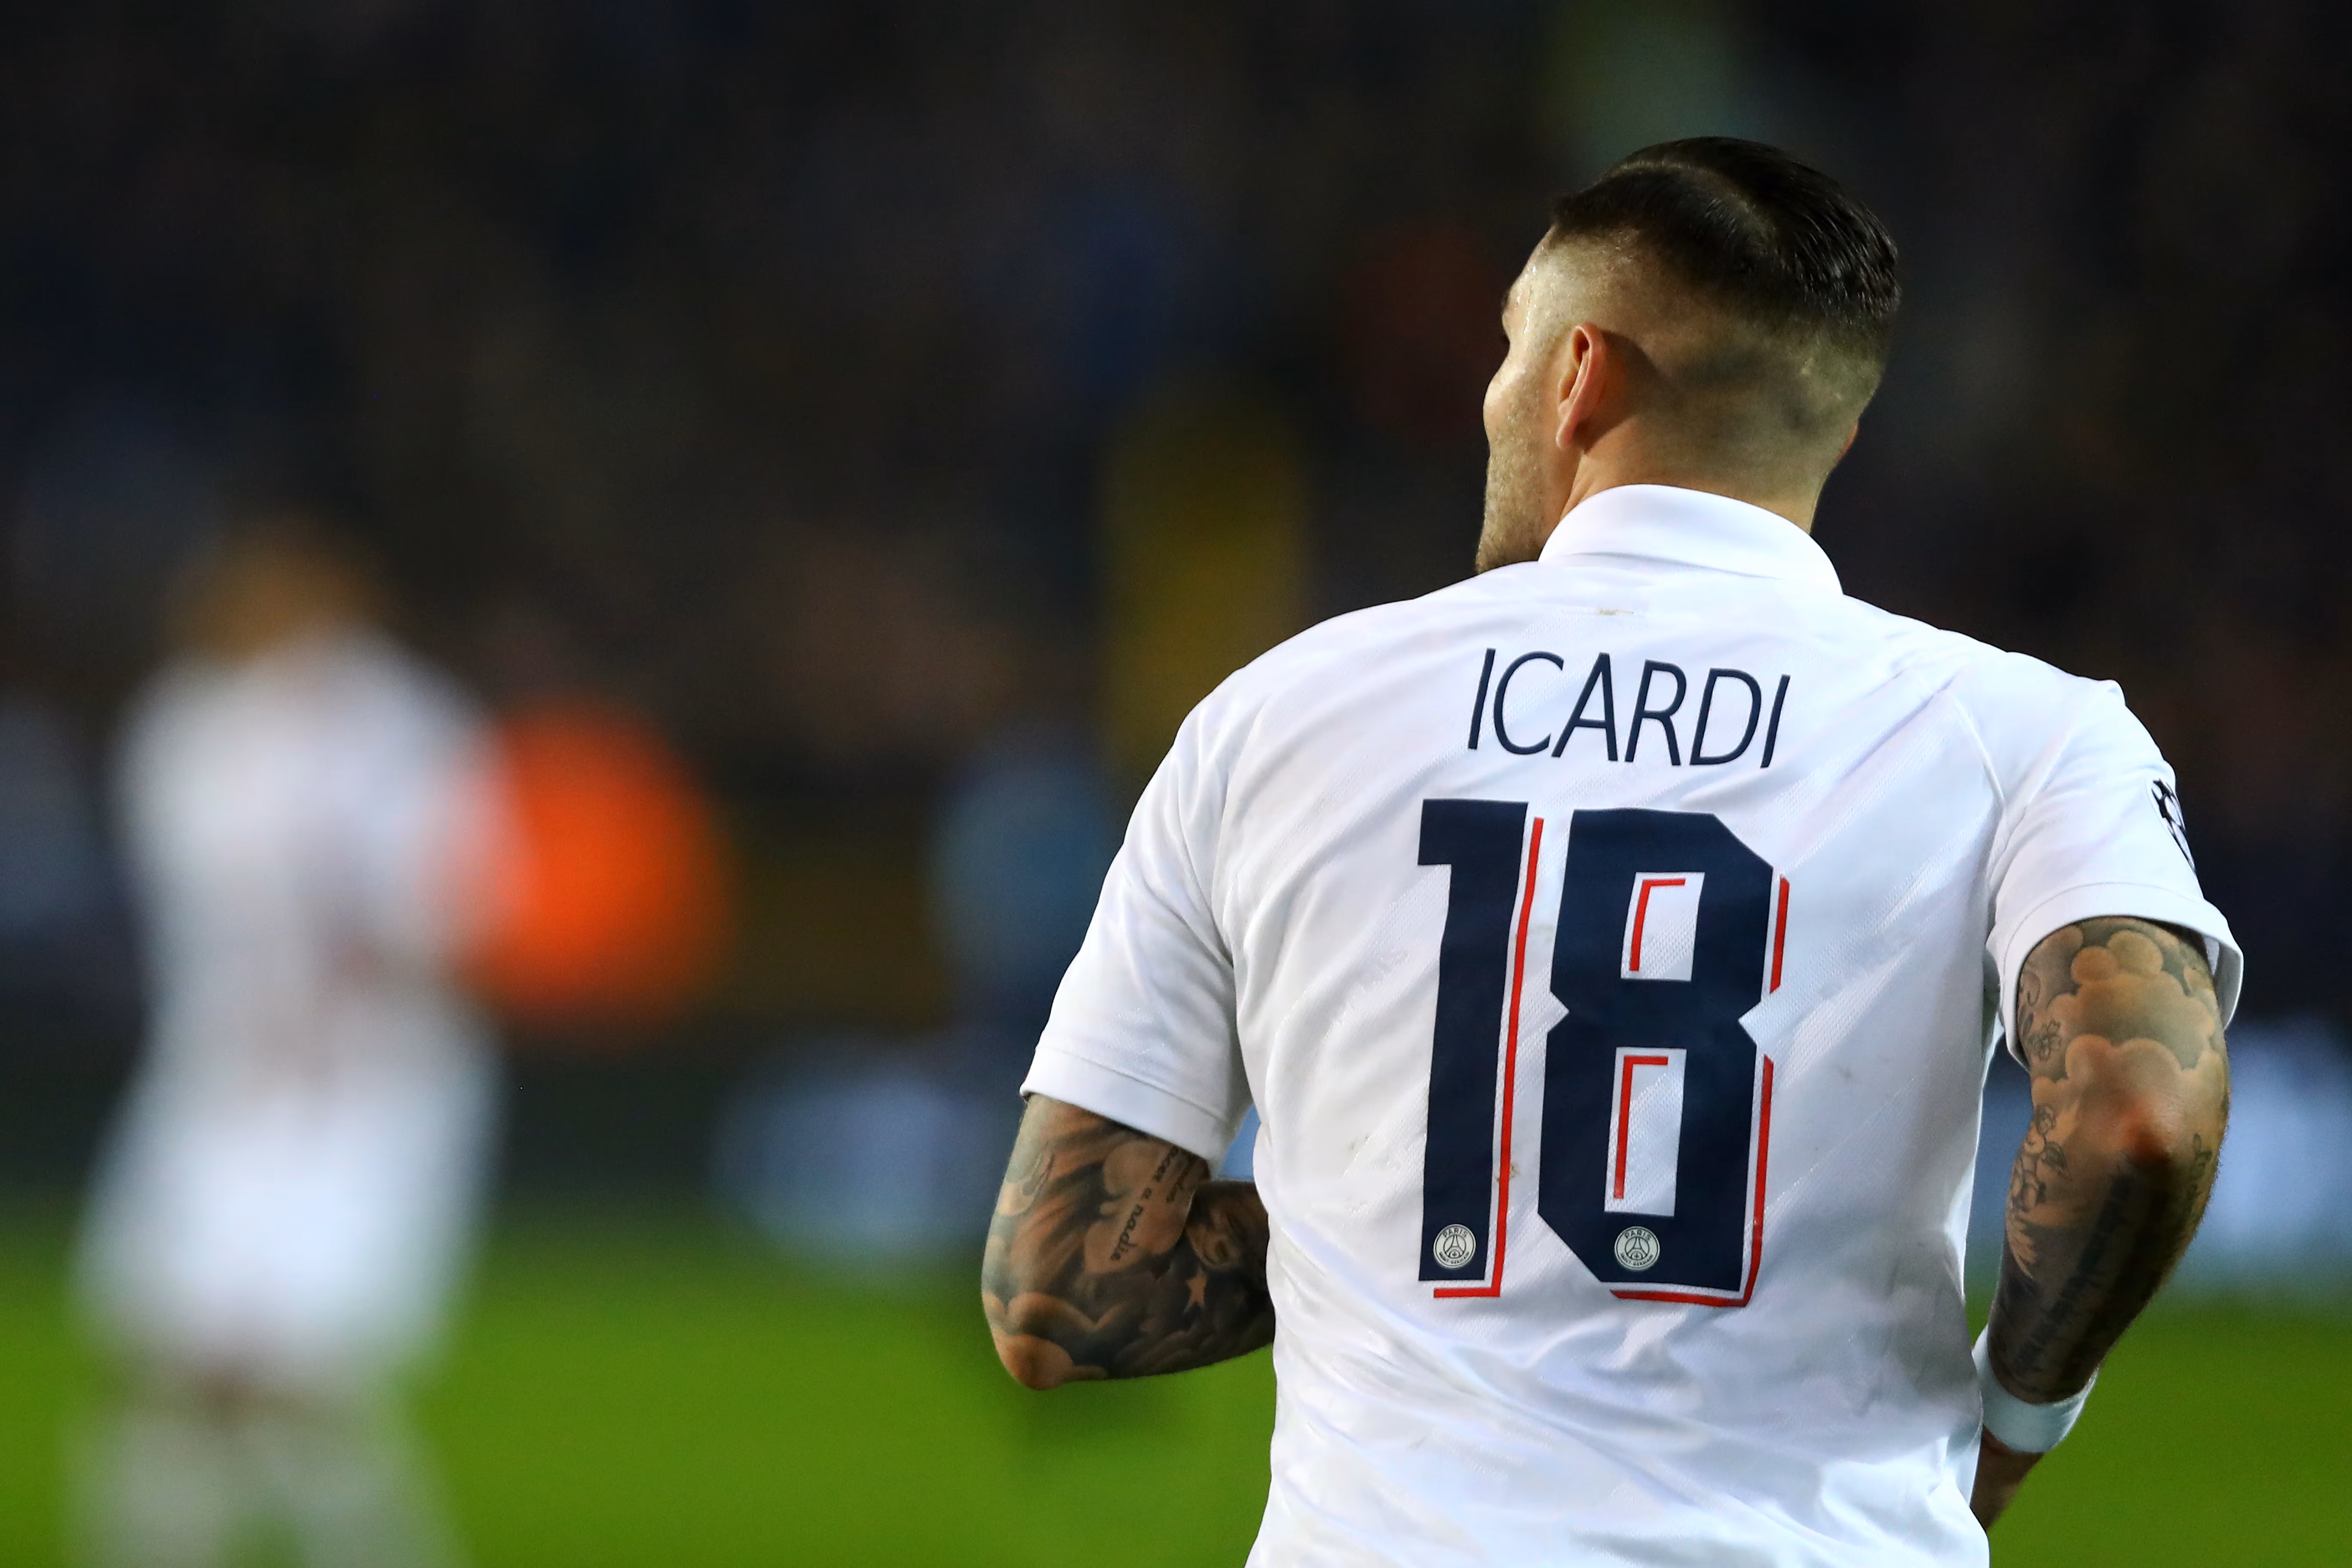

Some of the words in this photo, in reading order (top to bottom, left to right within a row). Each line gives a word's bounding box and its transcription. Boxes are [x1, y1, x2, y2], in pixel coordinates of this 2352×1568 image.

[1468, 648, 1790, 768] ICARDI
[1418, 799, 1789, 1307] 18
[1442, 1227, 1469, 1238] PARIS
[1624, 1229, 1651, 1240] PARIS
